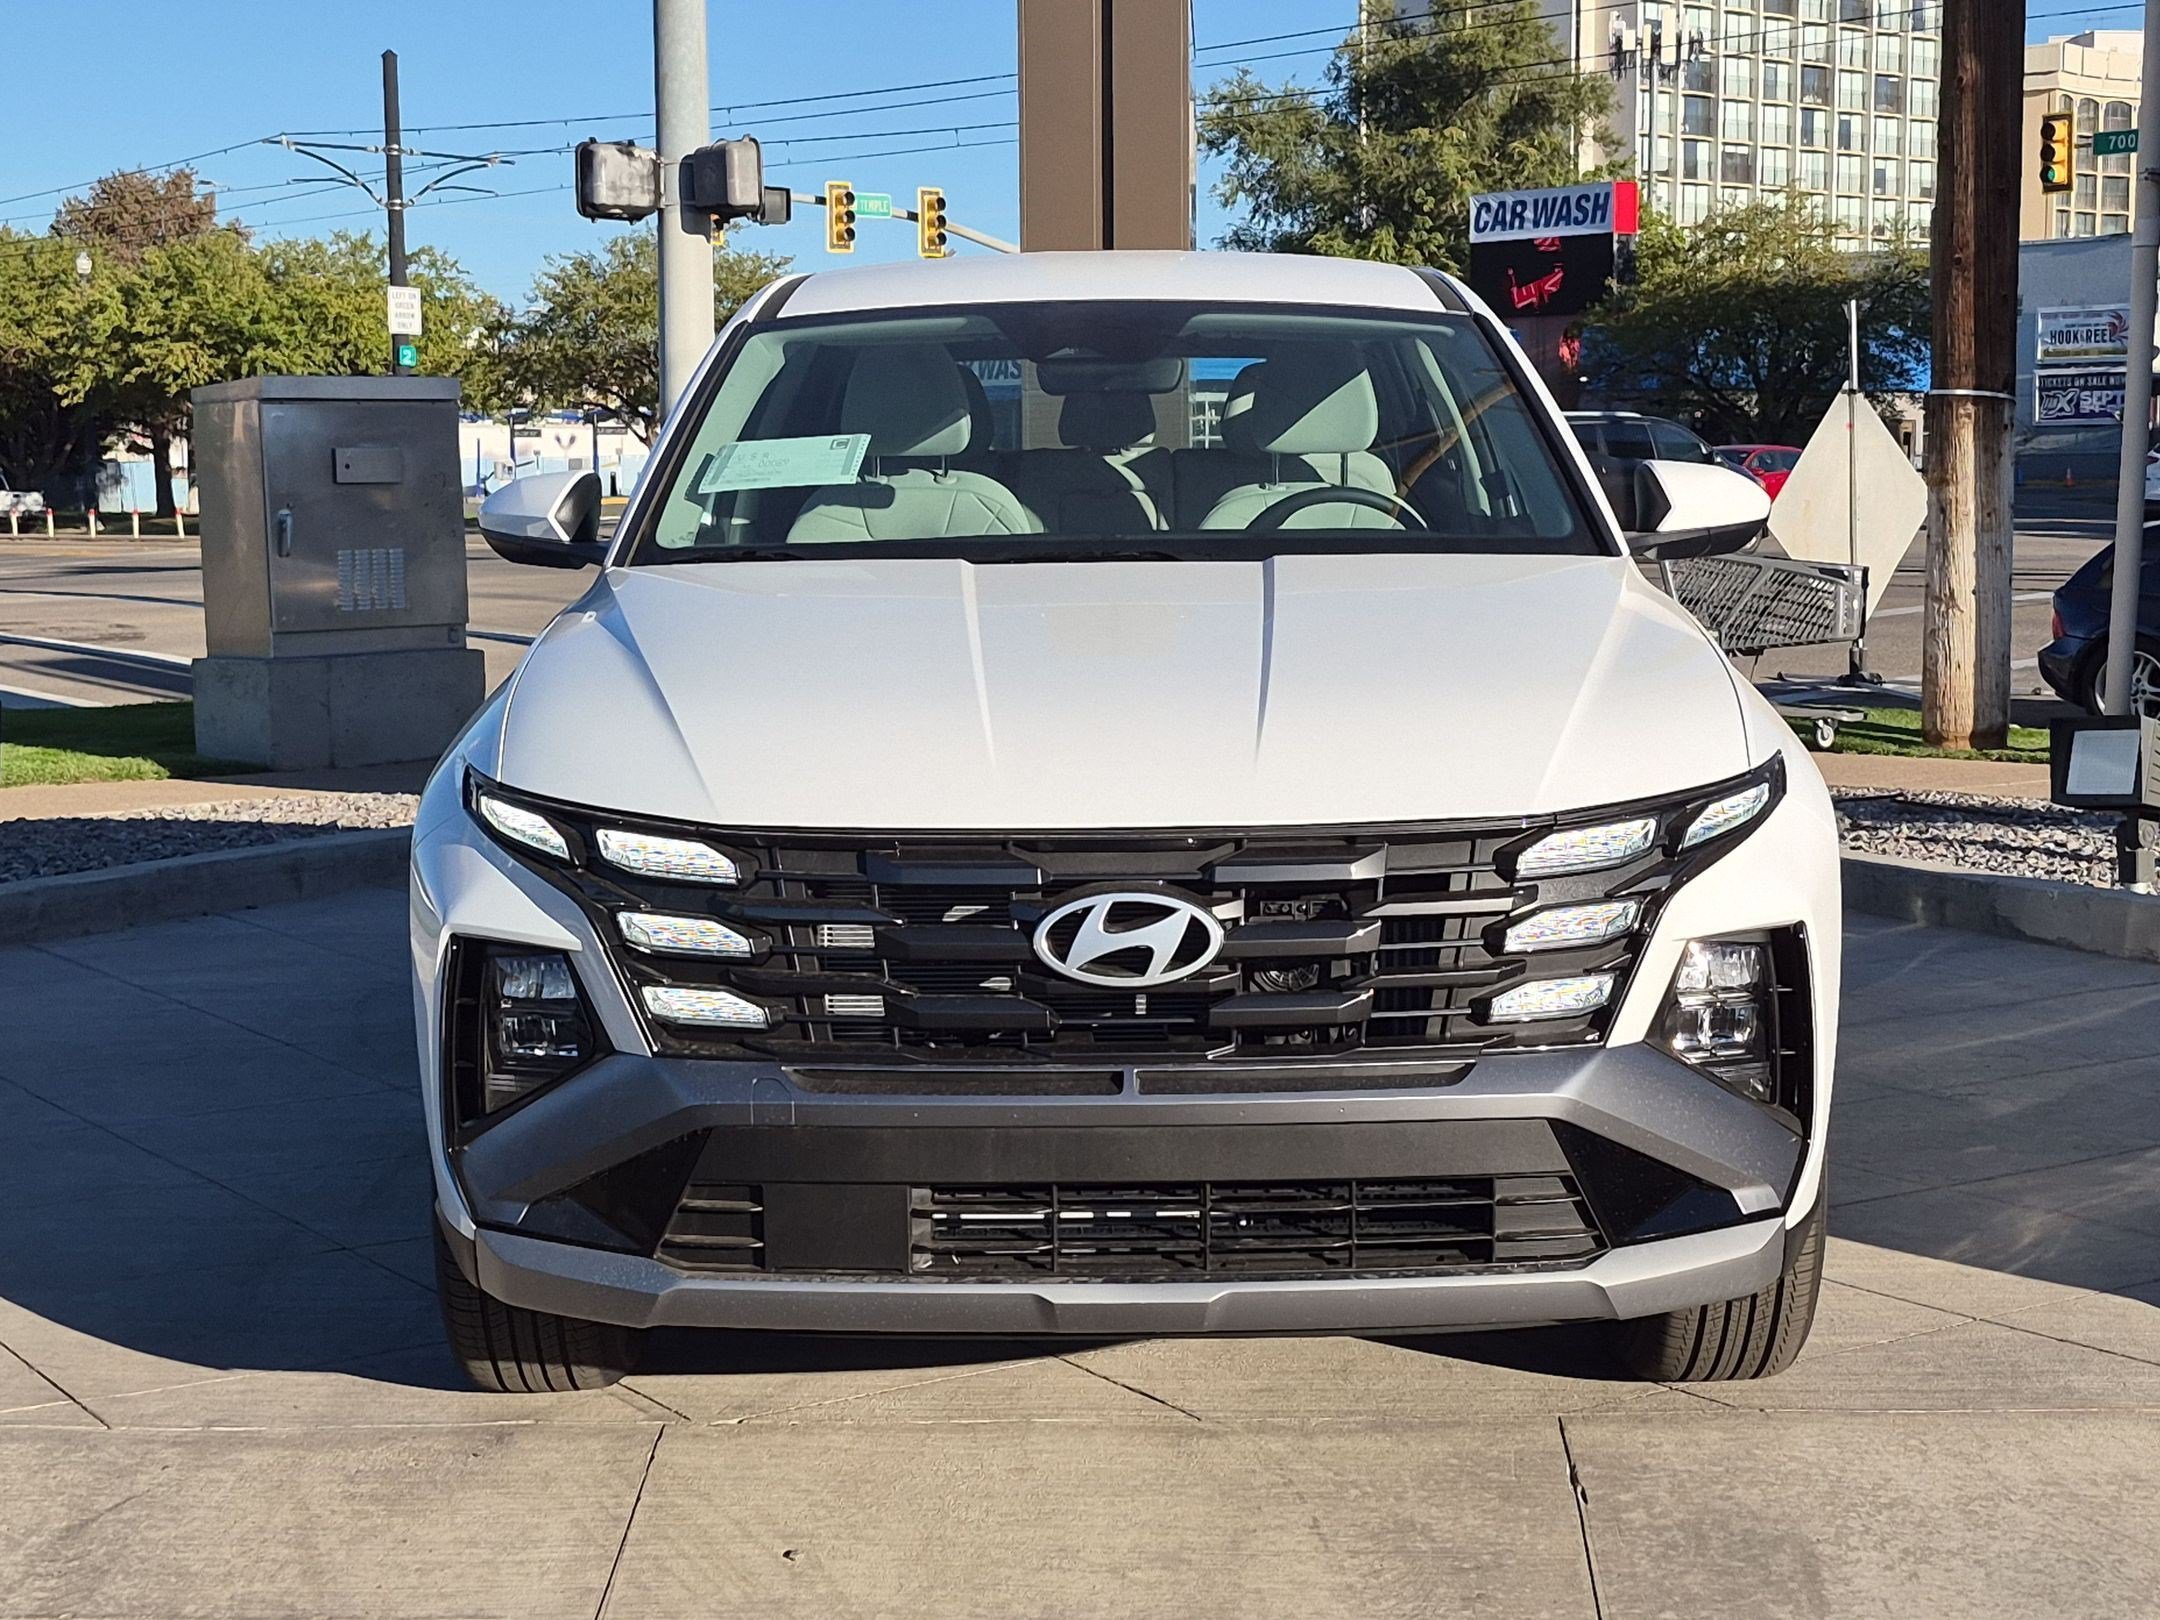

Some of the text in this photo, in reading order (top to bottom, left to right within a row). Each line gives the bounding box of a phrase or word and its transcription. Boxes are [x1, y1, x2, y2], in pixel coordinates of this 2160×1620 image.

[2108, 134, 2136, 150] 700
[1474, 191, 1611, 234] CAR WASH
[2050, 330, 2080, 345] HOOK
[2086, 328, 2117, 343] REEL
[978, 359, 1021, 380] WAS
[2087, 375, 2107, 387] SALE
[2079, 390, 2125, 405] SEPT
